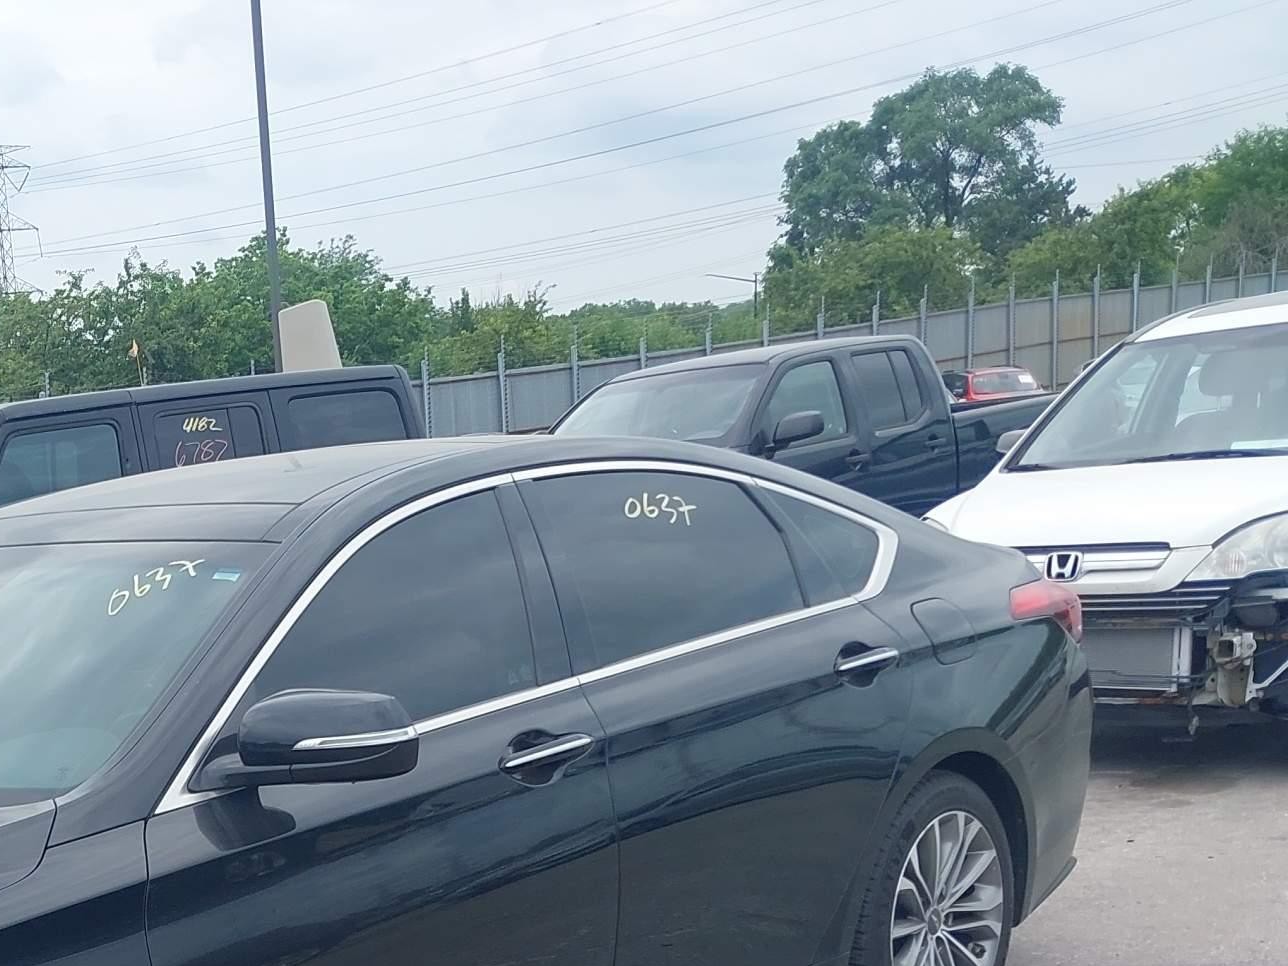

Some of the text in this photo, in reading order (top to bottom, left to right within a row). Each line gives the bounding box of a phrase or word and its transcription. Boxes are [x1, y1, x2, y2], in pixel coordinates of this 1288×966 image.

[182, 417, 223, 433] 4182
[175, 440, 228, 468] 6787
[624, 492, 697, 526] 0637
[108, 558, 206, 616] 0637
